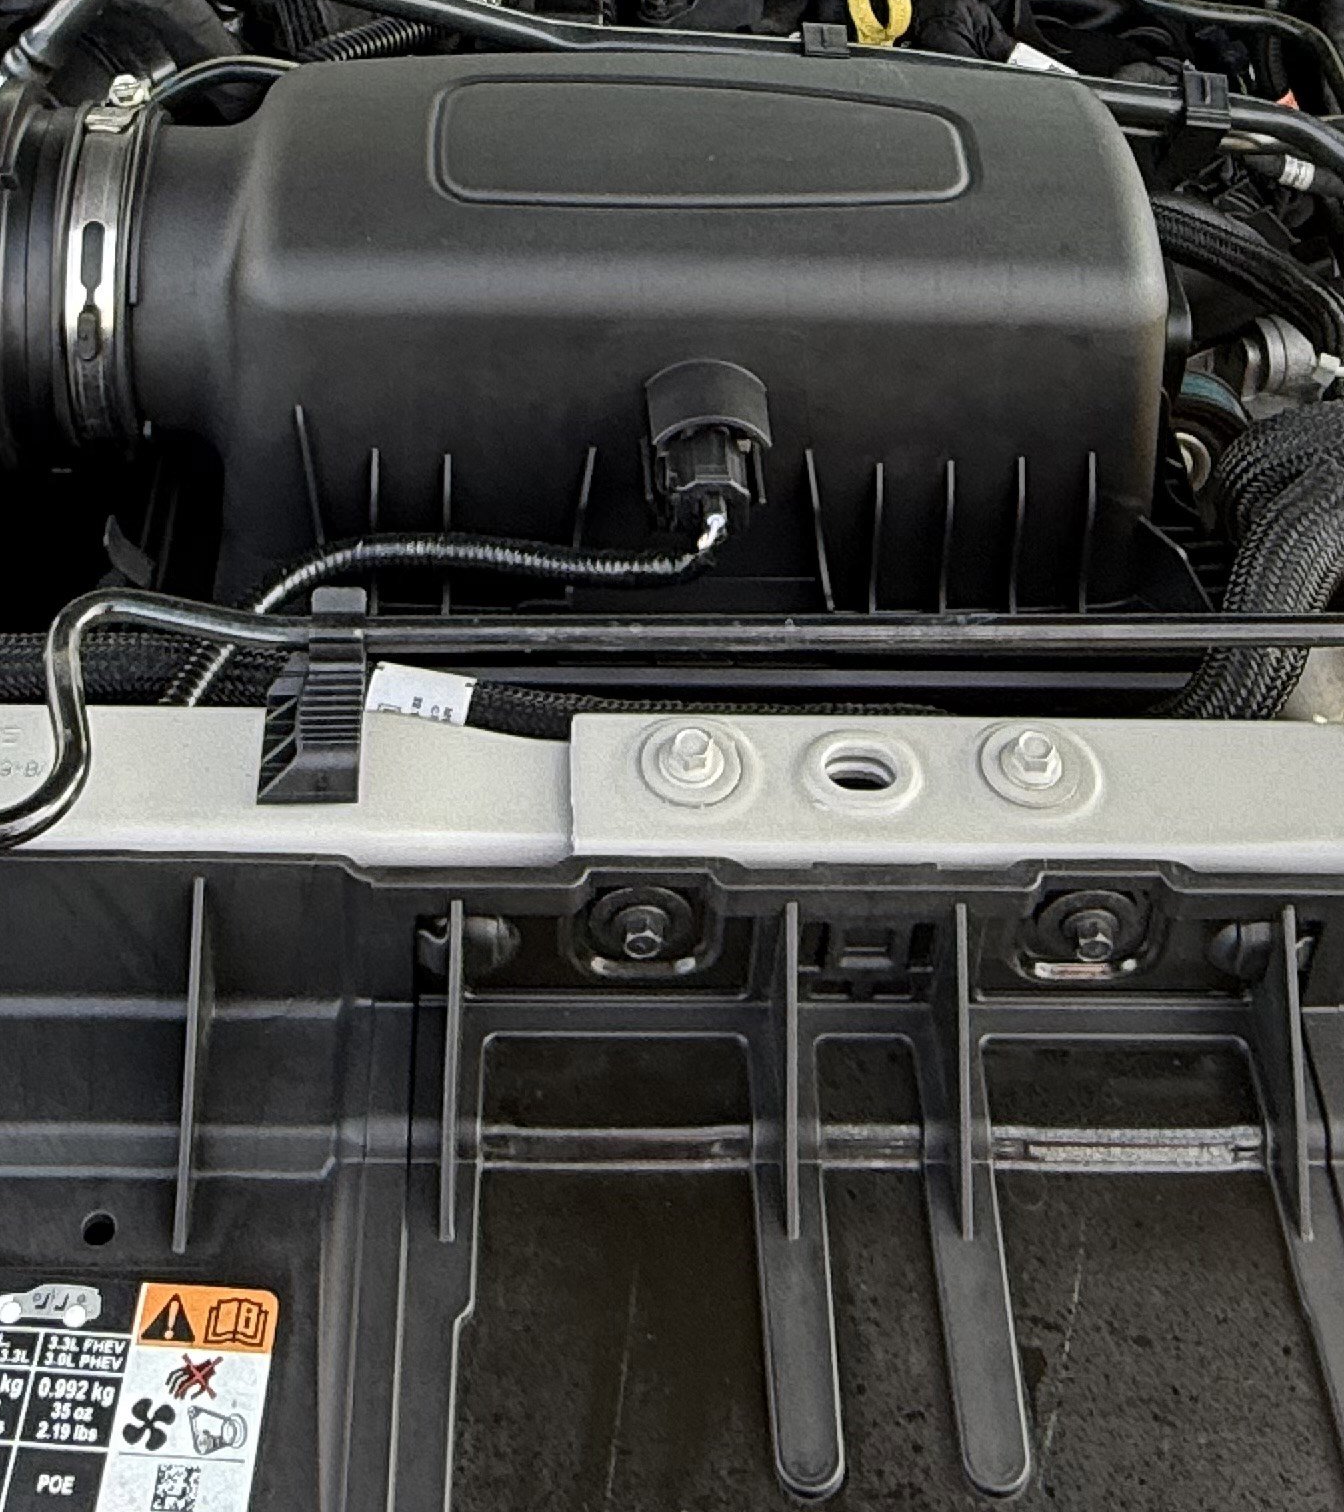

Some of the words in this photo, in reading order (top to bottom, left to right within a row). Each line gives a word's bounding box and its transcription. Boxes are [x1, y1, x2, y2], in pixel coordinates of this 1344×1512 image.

[48, 1336, 80, 1352] 3.3L
[0, 1348, 30, 1364] 3.3L
[44, 1351, 76, 1368] 3.0L
[79, 1354, 124, 1370] PHEV
[0, 1373, 25, 1400] kg
[38, 1376, 90, 1400] 0.992
[91, 1380, 116, 1408] kg
[50, 1401, 72, 1420] 35
[73, 1406, 94, 1422] oz
[36, 1421, 72, 1441] 2.19
[72, 1423, 98, 1442] lbs
[36, 1473, 76, 1495] POE
